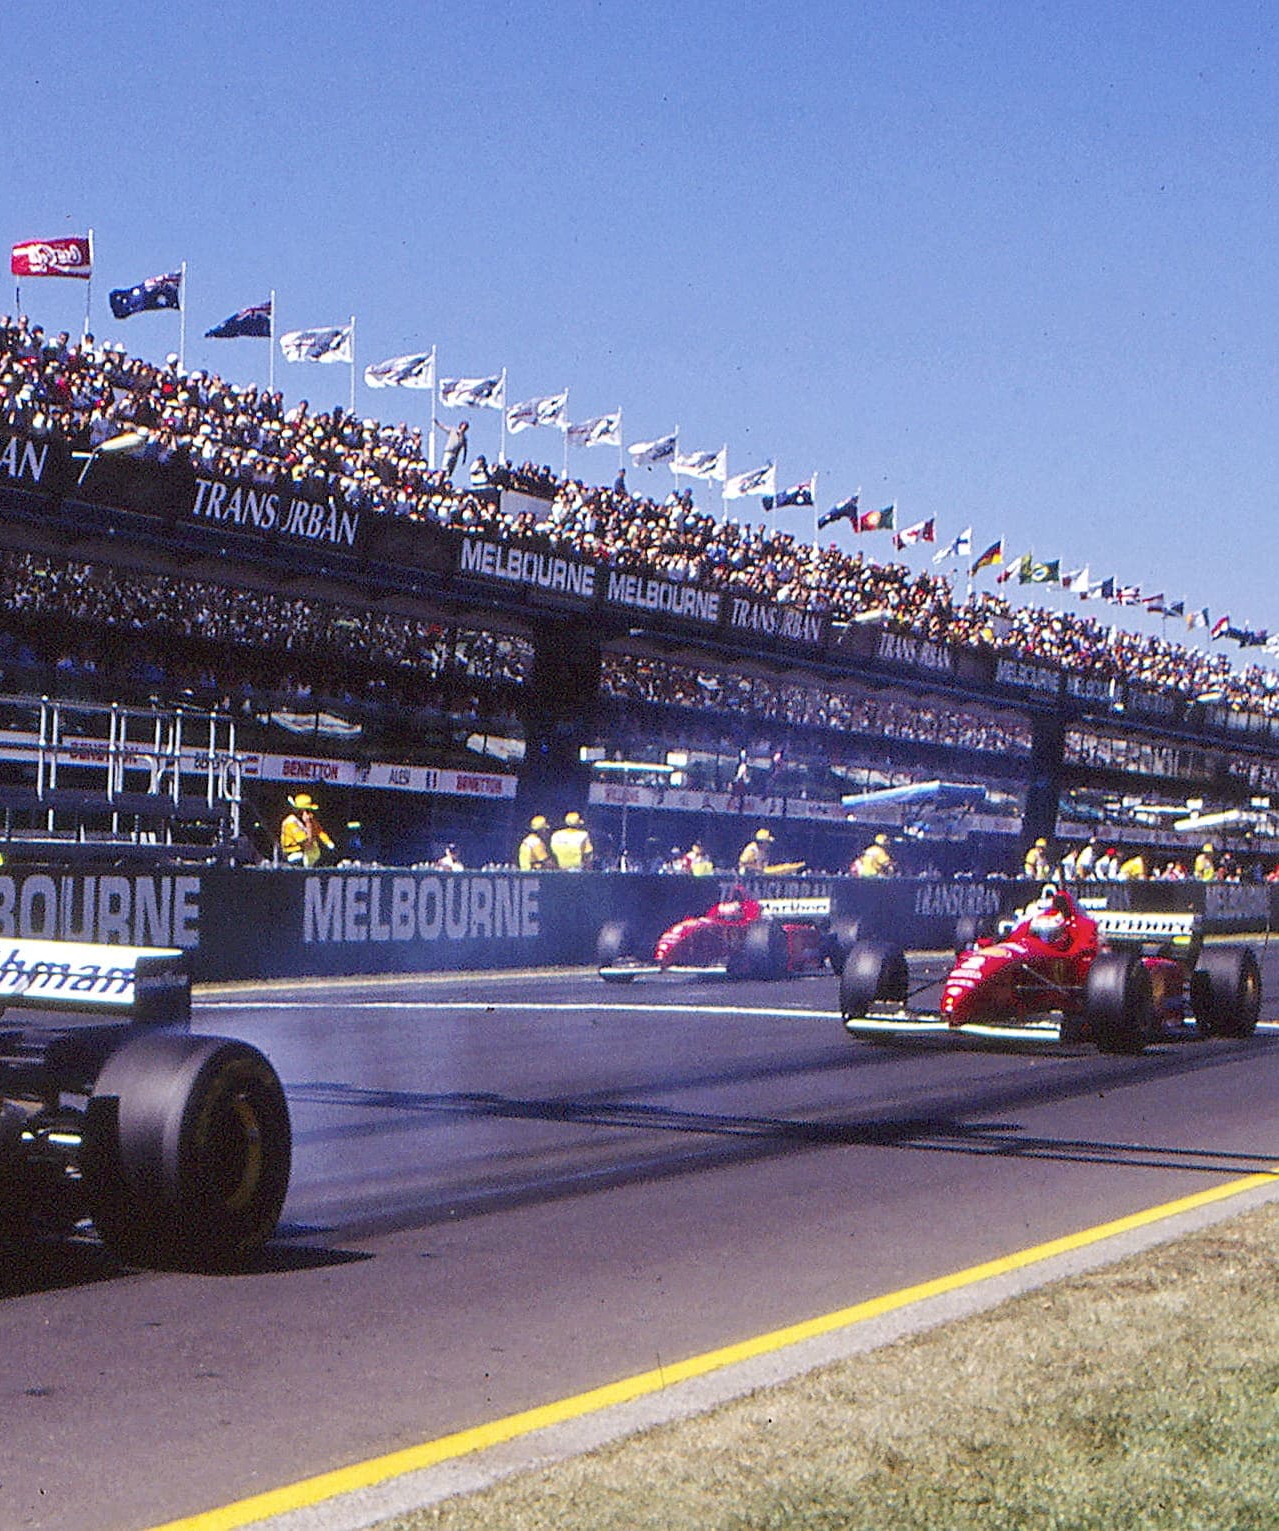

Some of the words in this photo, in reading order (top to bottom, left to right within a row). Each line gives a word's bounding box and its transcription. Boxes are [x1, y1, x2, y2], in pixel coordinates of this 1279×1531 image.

[461, 539, 595, 598] MELBOURNE
[608, 572, 719, 622] MELBOURNE
[282, 758, 338, 780] BENETTON
[304, 876, 540, 942] MELBOURNE
